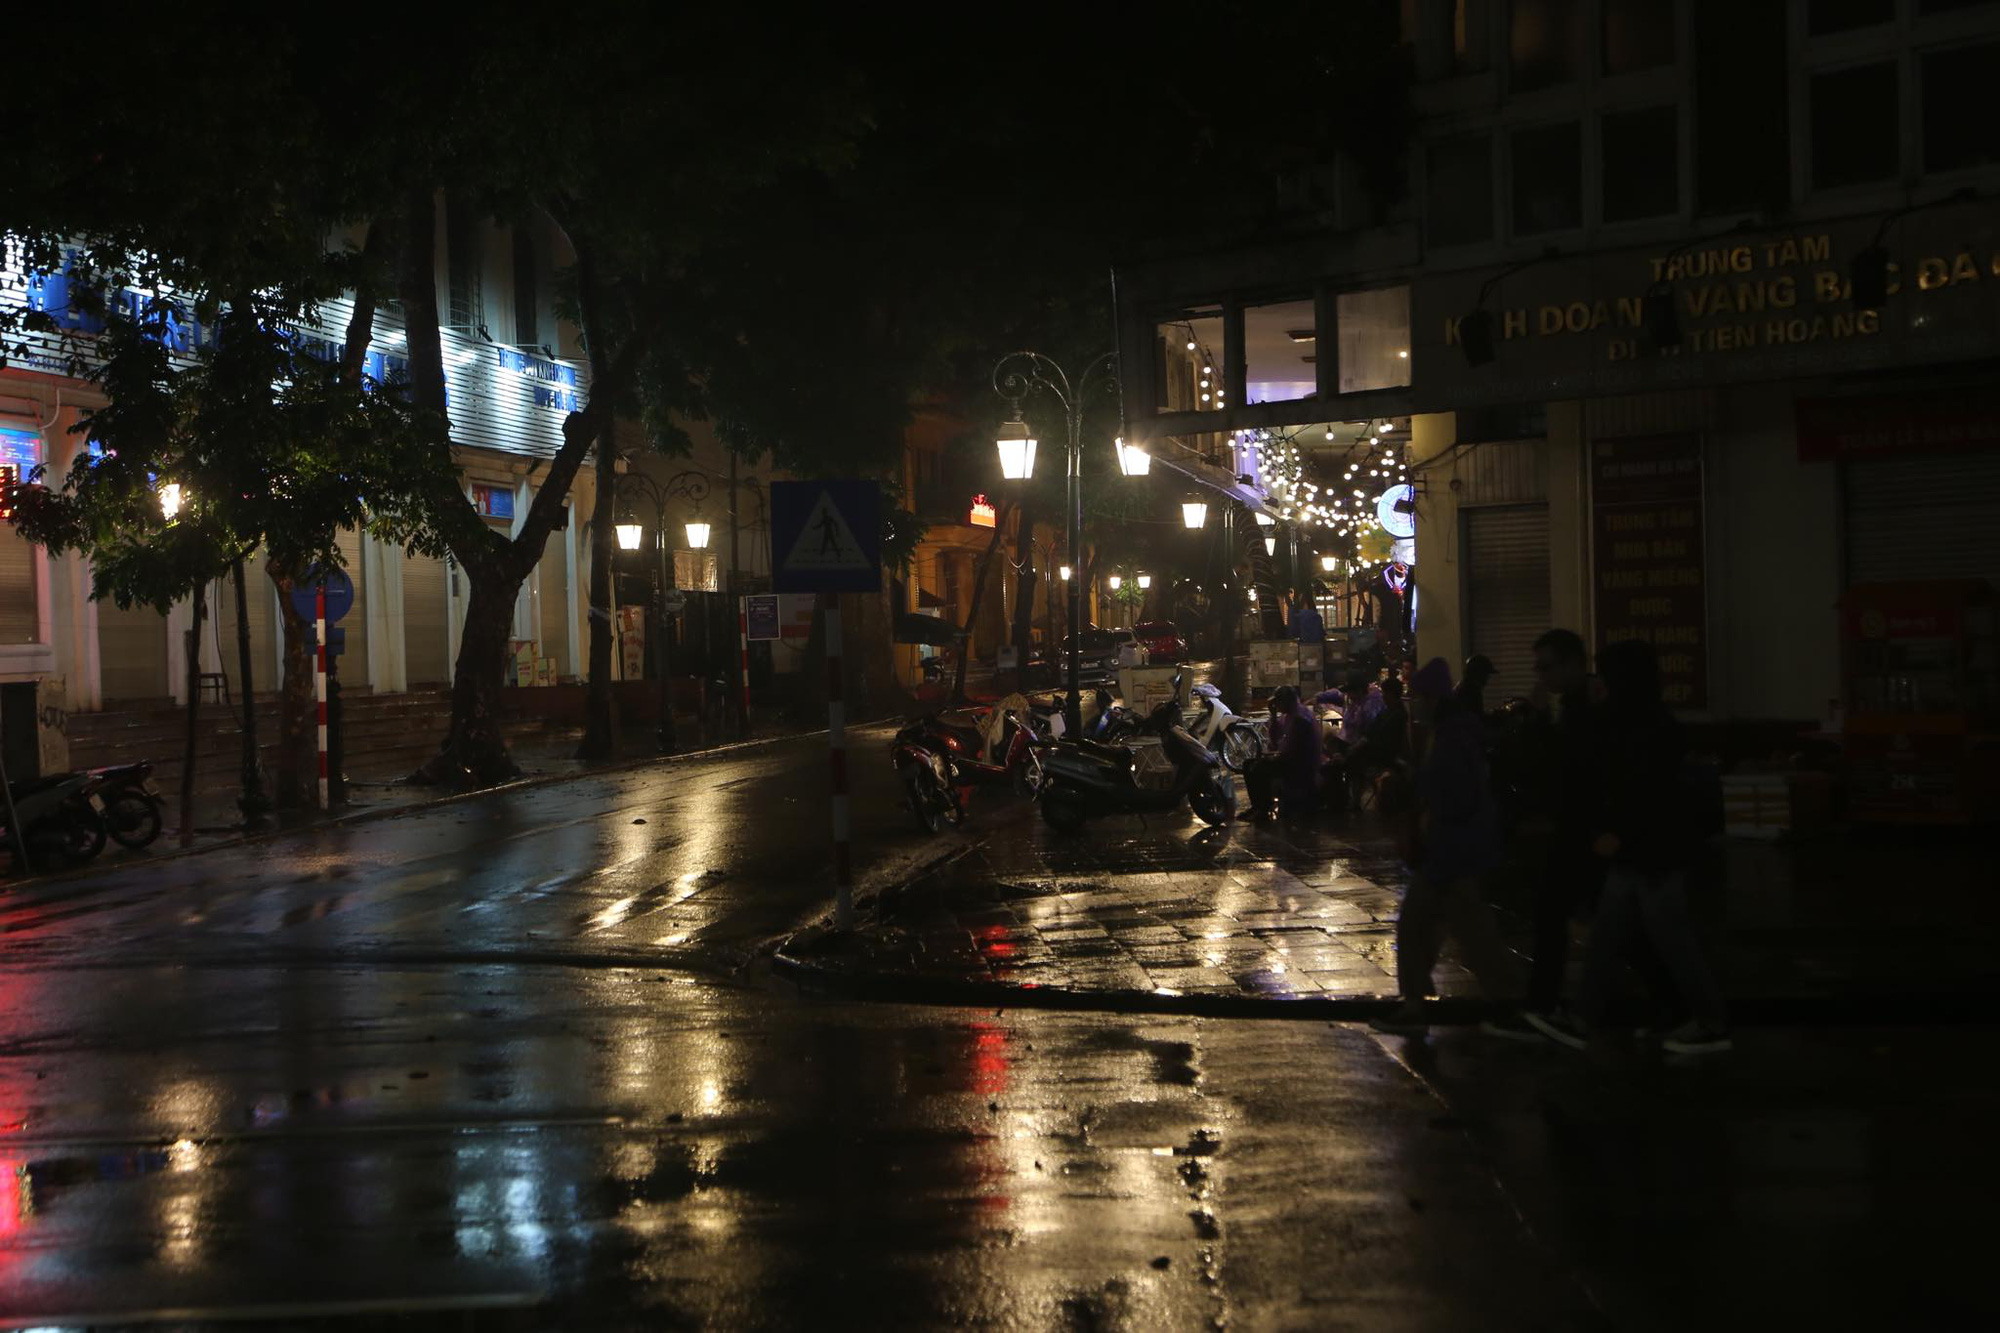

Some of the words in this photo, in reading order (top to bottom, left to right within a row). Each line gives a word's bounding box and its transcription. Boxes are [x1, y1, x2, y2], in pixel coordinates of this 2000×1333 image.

[1649, 246, 1753, 282] TRUNG
[1445, 308, 1527, 346] KH
[1539, 297, 1642, 335] DOAN
